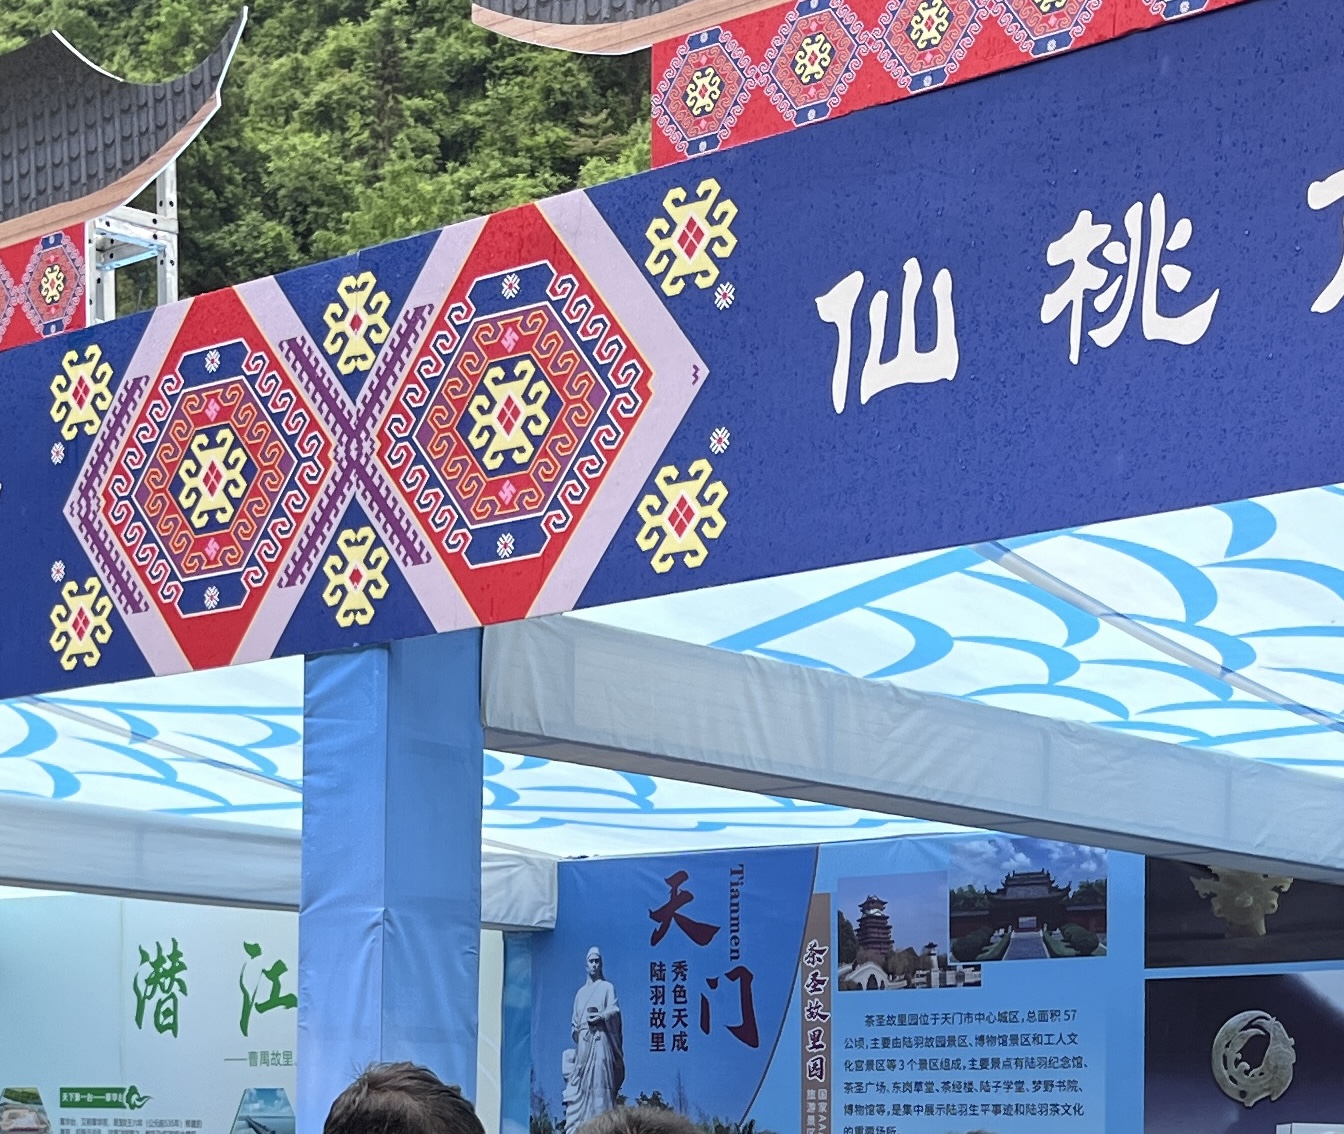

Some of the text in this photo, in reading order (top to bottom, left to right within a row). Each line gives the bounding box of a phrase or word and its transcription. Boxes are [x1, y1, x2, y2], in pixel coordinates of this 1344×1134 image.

[648, 869, 760, 1048] 天门
[729, 863, 745, 962] Tianmen
[132, 937, 299, 1039] 潜江
[649, 960, 667, 1053] 陆羽故里
[670, 960, 689, 1053] 秀色天成
[803, 939, 831, 1082] 茶圣故里园
